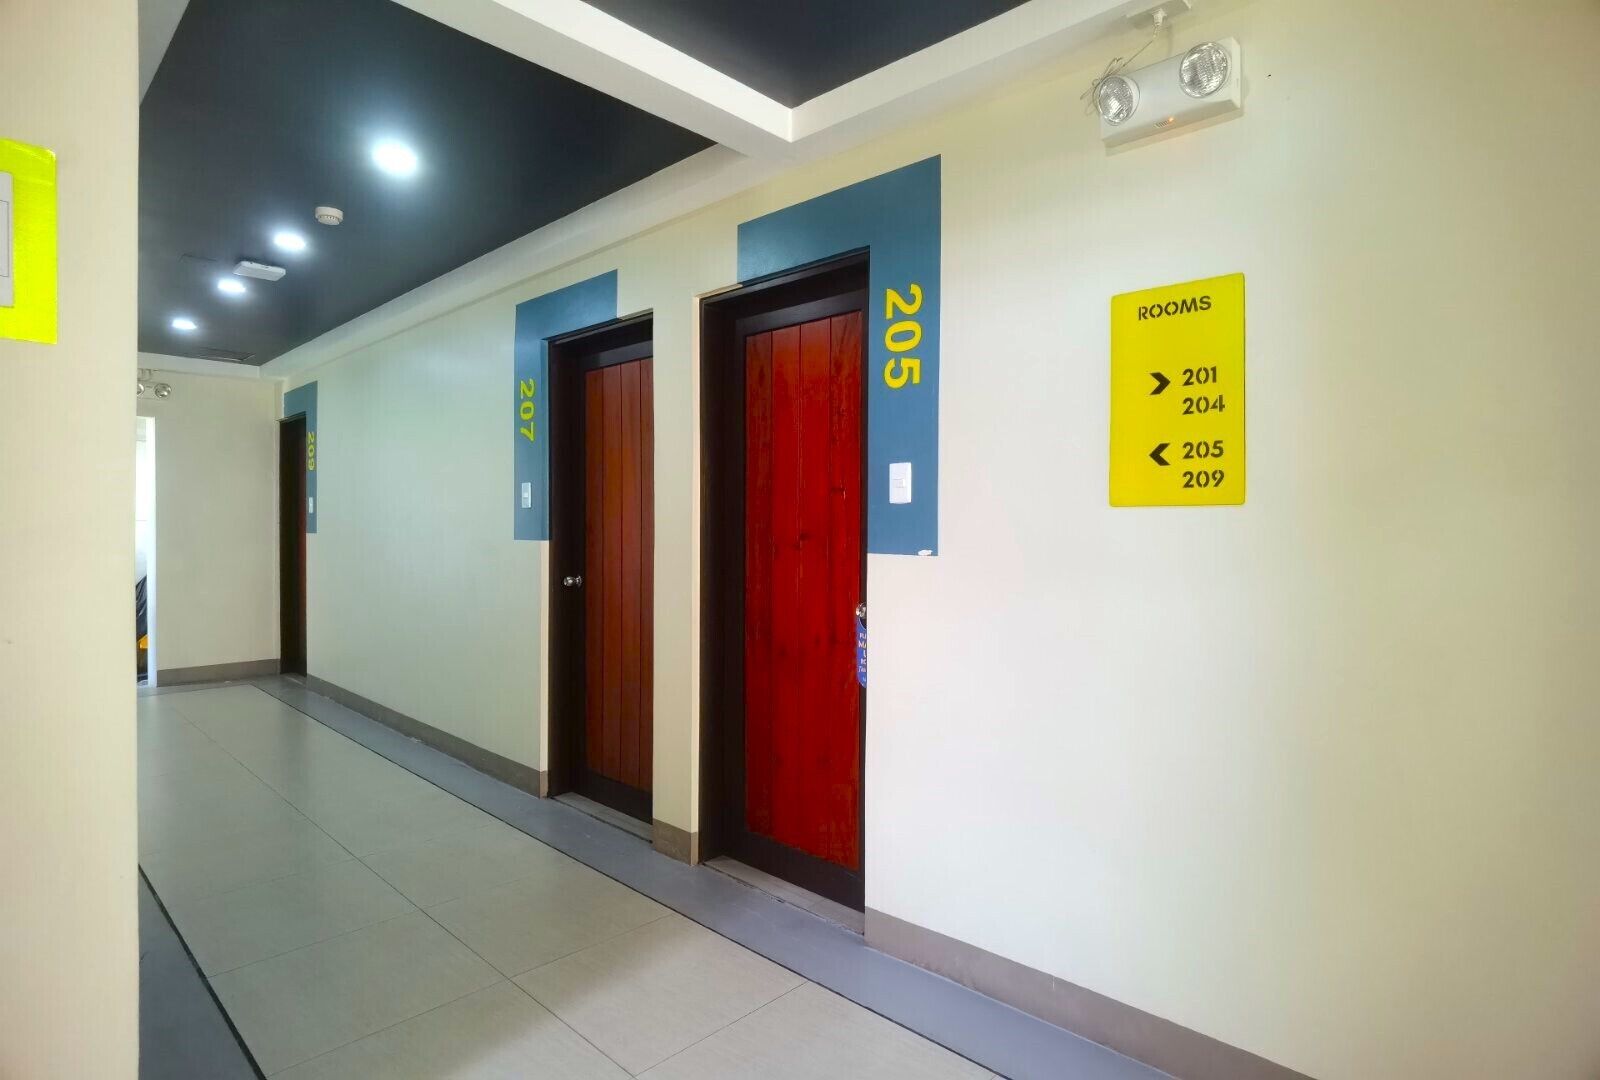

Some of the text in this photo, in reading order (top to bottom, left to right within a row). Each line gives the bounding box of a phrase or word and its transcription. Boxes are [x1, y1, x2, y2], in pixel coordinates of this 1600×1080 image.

[1138, 295, 1212, 321] ROOMS
[884, 283, 923, 389] 205
[1182, 366, 1218, 387] 201
[520, 378, 535, 442] 207
[1182, 394, 1226, 415] 204
[307, 432, 316, 471] 209
[1182, 440, 1225, 460] 205
[1182, 469, 1225, 489] 209
